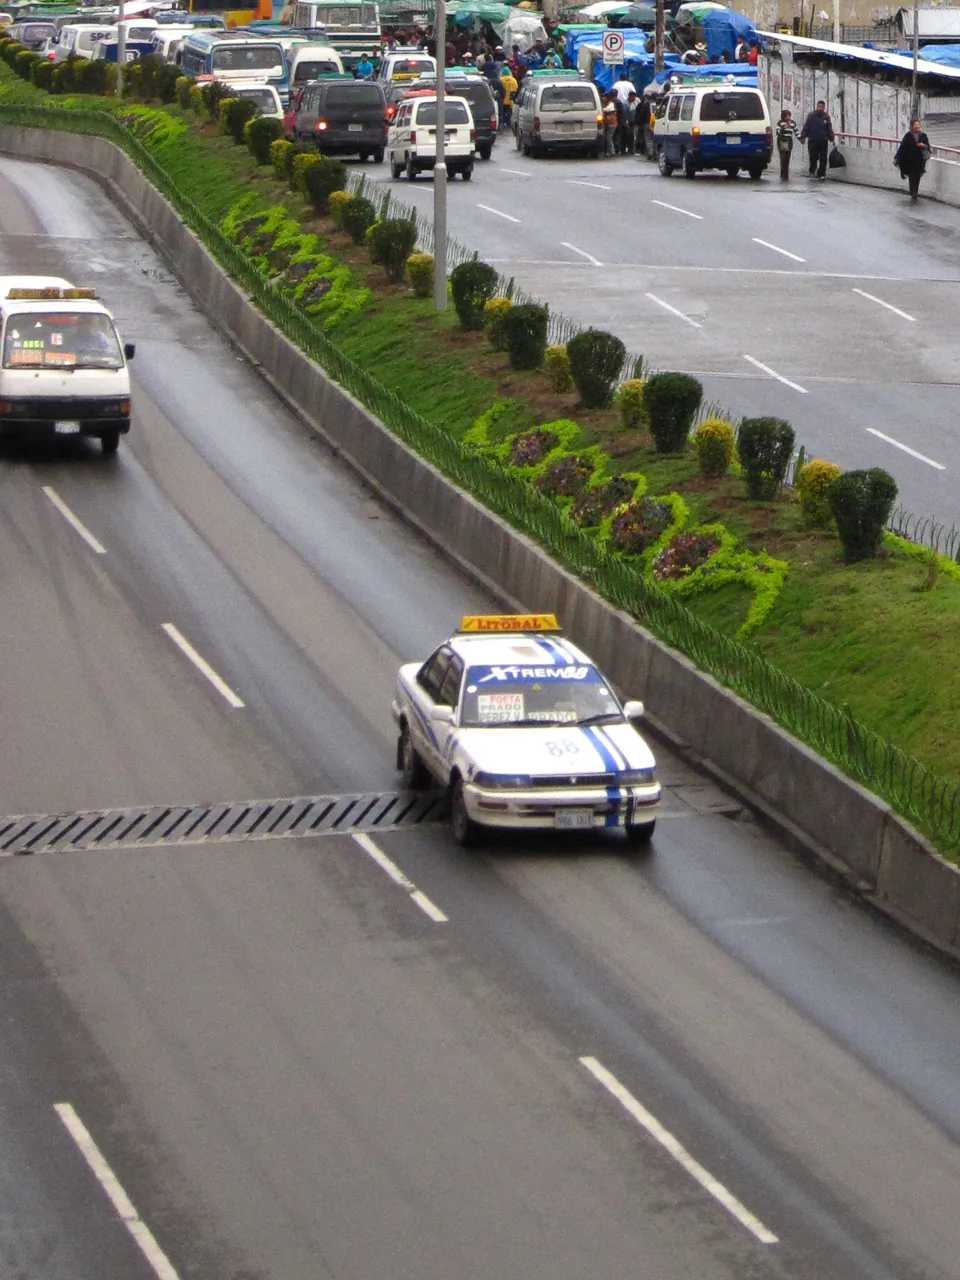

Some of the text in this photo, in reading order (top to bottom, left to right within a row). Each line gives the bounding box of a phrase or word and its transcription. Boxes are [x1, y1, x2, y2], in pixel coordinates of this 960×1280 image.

[609, 36, 619, 49] P
[476, 618, 541, 630] LITORAL
[479, 704, 522, 712] PRADO
[479, 712, 511, 722] PEREZ
[545, 739, 580, 757] 88
